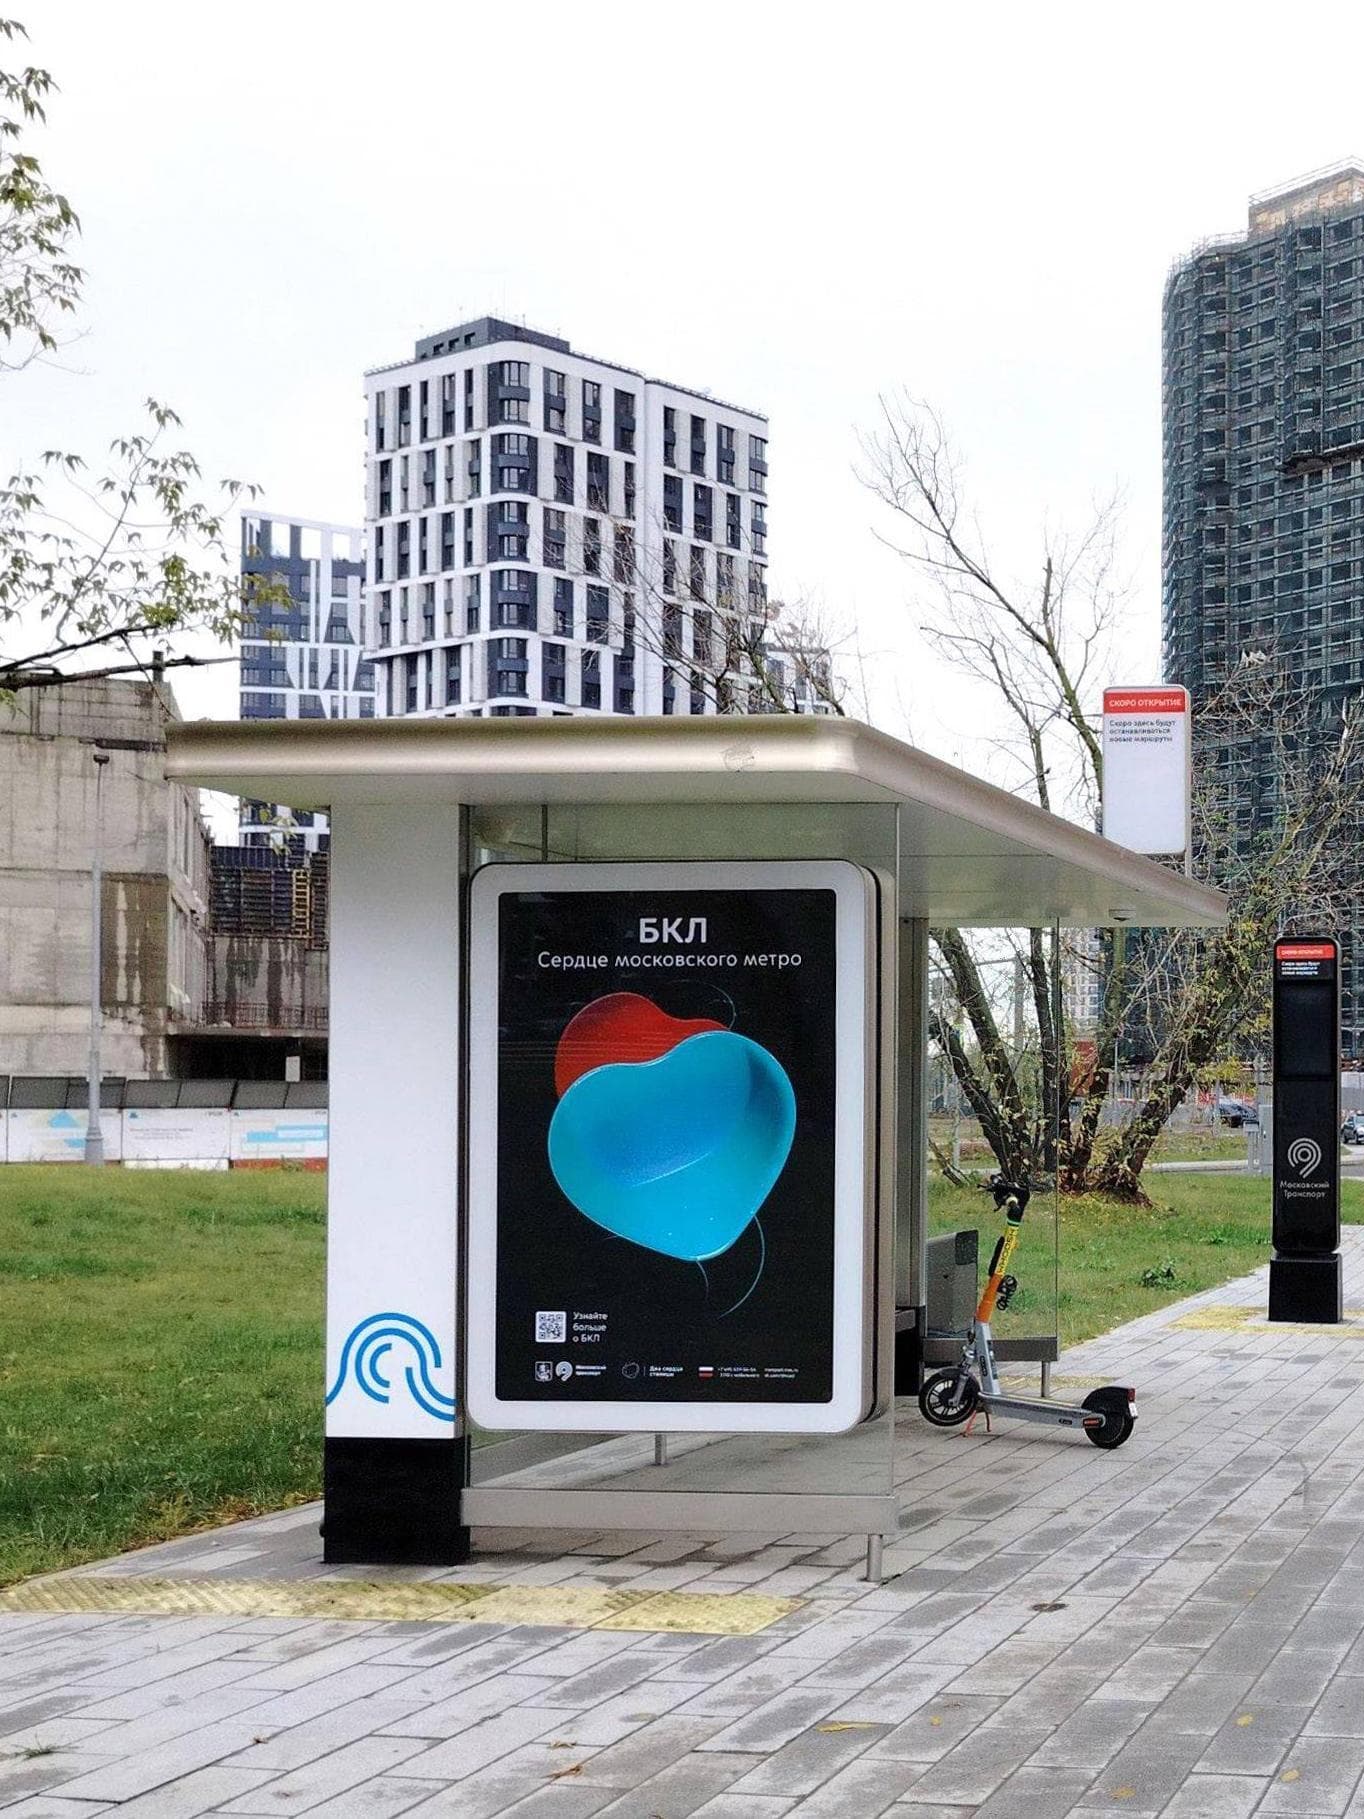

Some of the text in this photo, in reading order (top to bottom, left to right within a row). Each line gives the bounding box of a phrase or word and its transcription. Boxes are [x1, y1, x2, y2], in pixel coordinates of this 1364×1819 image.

[1109, 698, 1182, 707] СКОРО ОТКРЫТИЕ
[1109, 719, 1132, 727] Скоро
[639, 917, 708, 944] БКЛ
[537, 951, 802, 971] Сердце московского метро
[1280, 1180, 1330, 1189] Московский
[1283, 1189, 1326, 1200] Транспорт
[573, 1311, 608, 1320] Узнайте
[572, 1323, 607, 1332] больше
[581, 1334, 600, 1342] БКЛ
